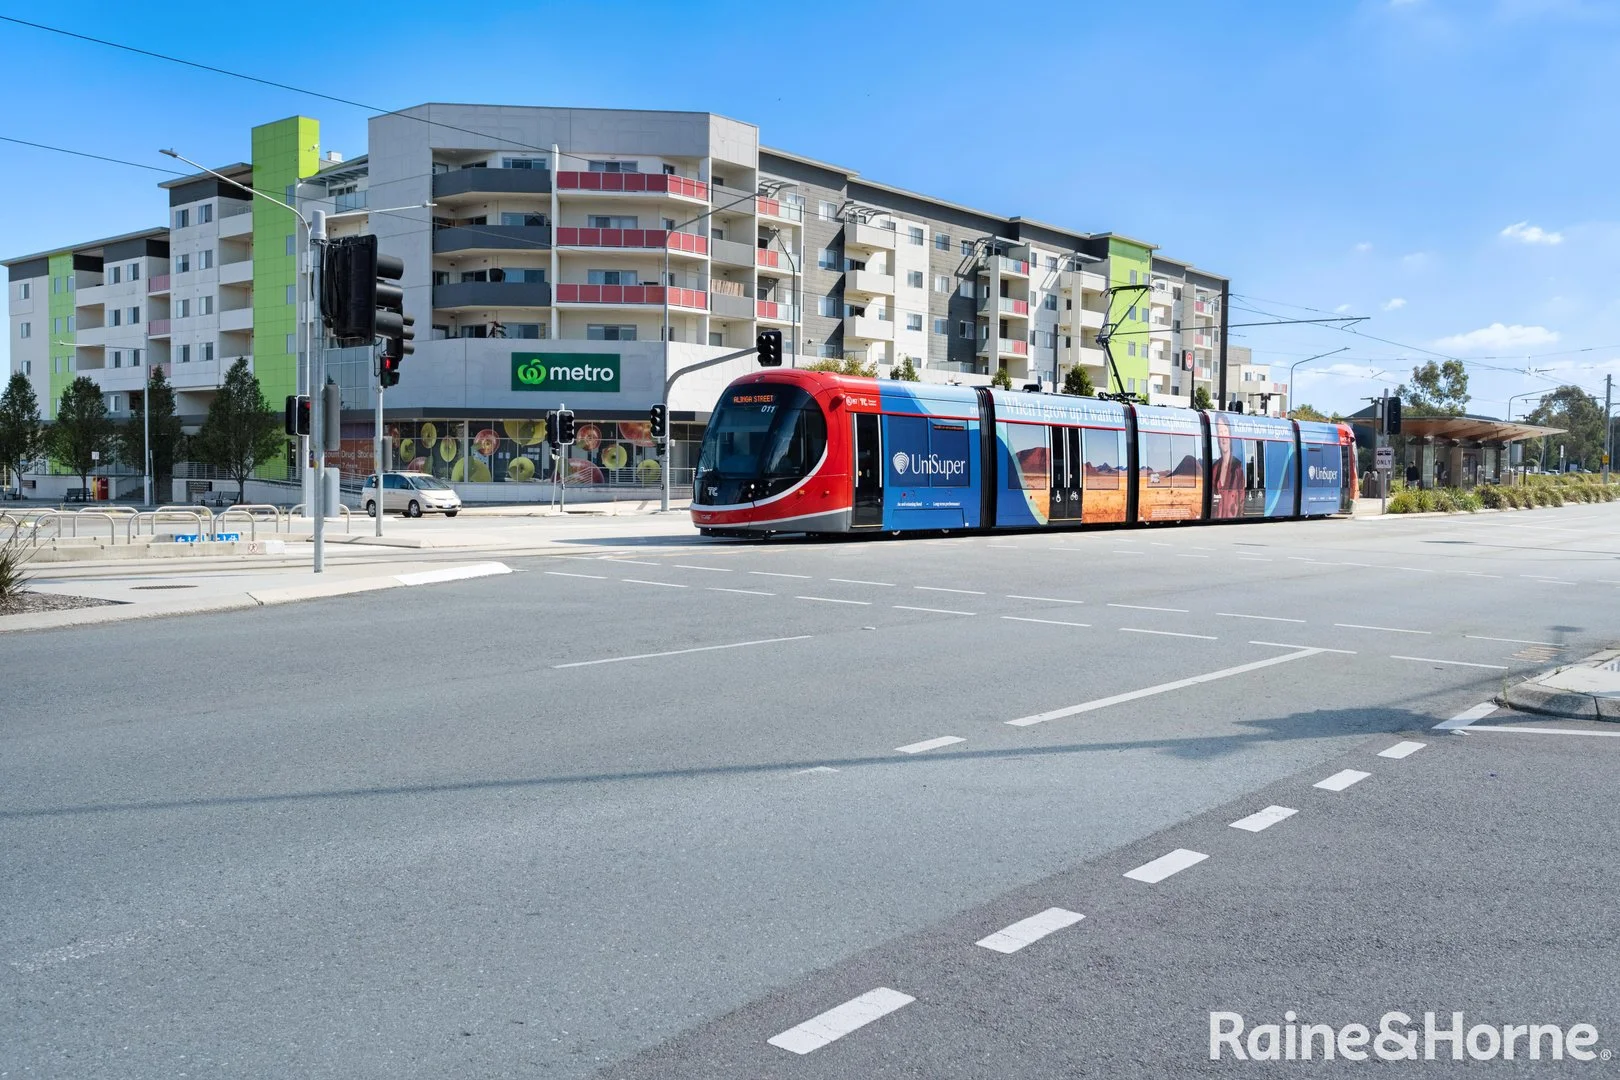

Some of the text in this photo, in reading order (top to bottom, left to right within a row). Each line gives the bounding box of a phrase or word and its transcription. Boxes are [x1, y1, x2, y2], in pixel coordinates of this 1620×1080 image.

[549, 363, 614, 382] metro
[733, 394, 775, 404] ALINGA STREET
[761, 405, 776, 413] 011
[1004, 396, 1036, 417] When
[1036, 400, 1042, 417] I
[1043, 404, 1068, 422] grow
[1068, 407, 1083, 424] up
[1083, 405, 1089, 421] I
[1089, 407, 1113, 423] want
[1113, 408, 1124, 424] to
[911, 453, 966, 480] UniSuper
[1315, 466, 1338, 484] UniSuper
